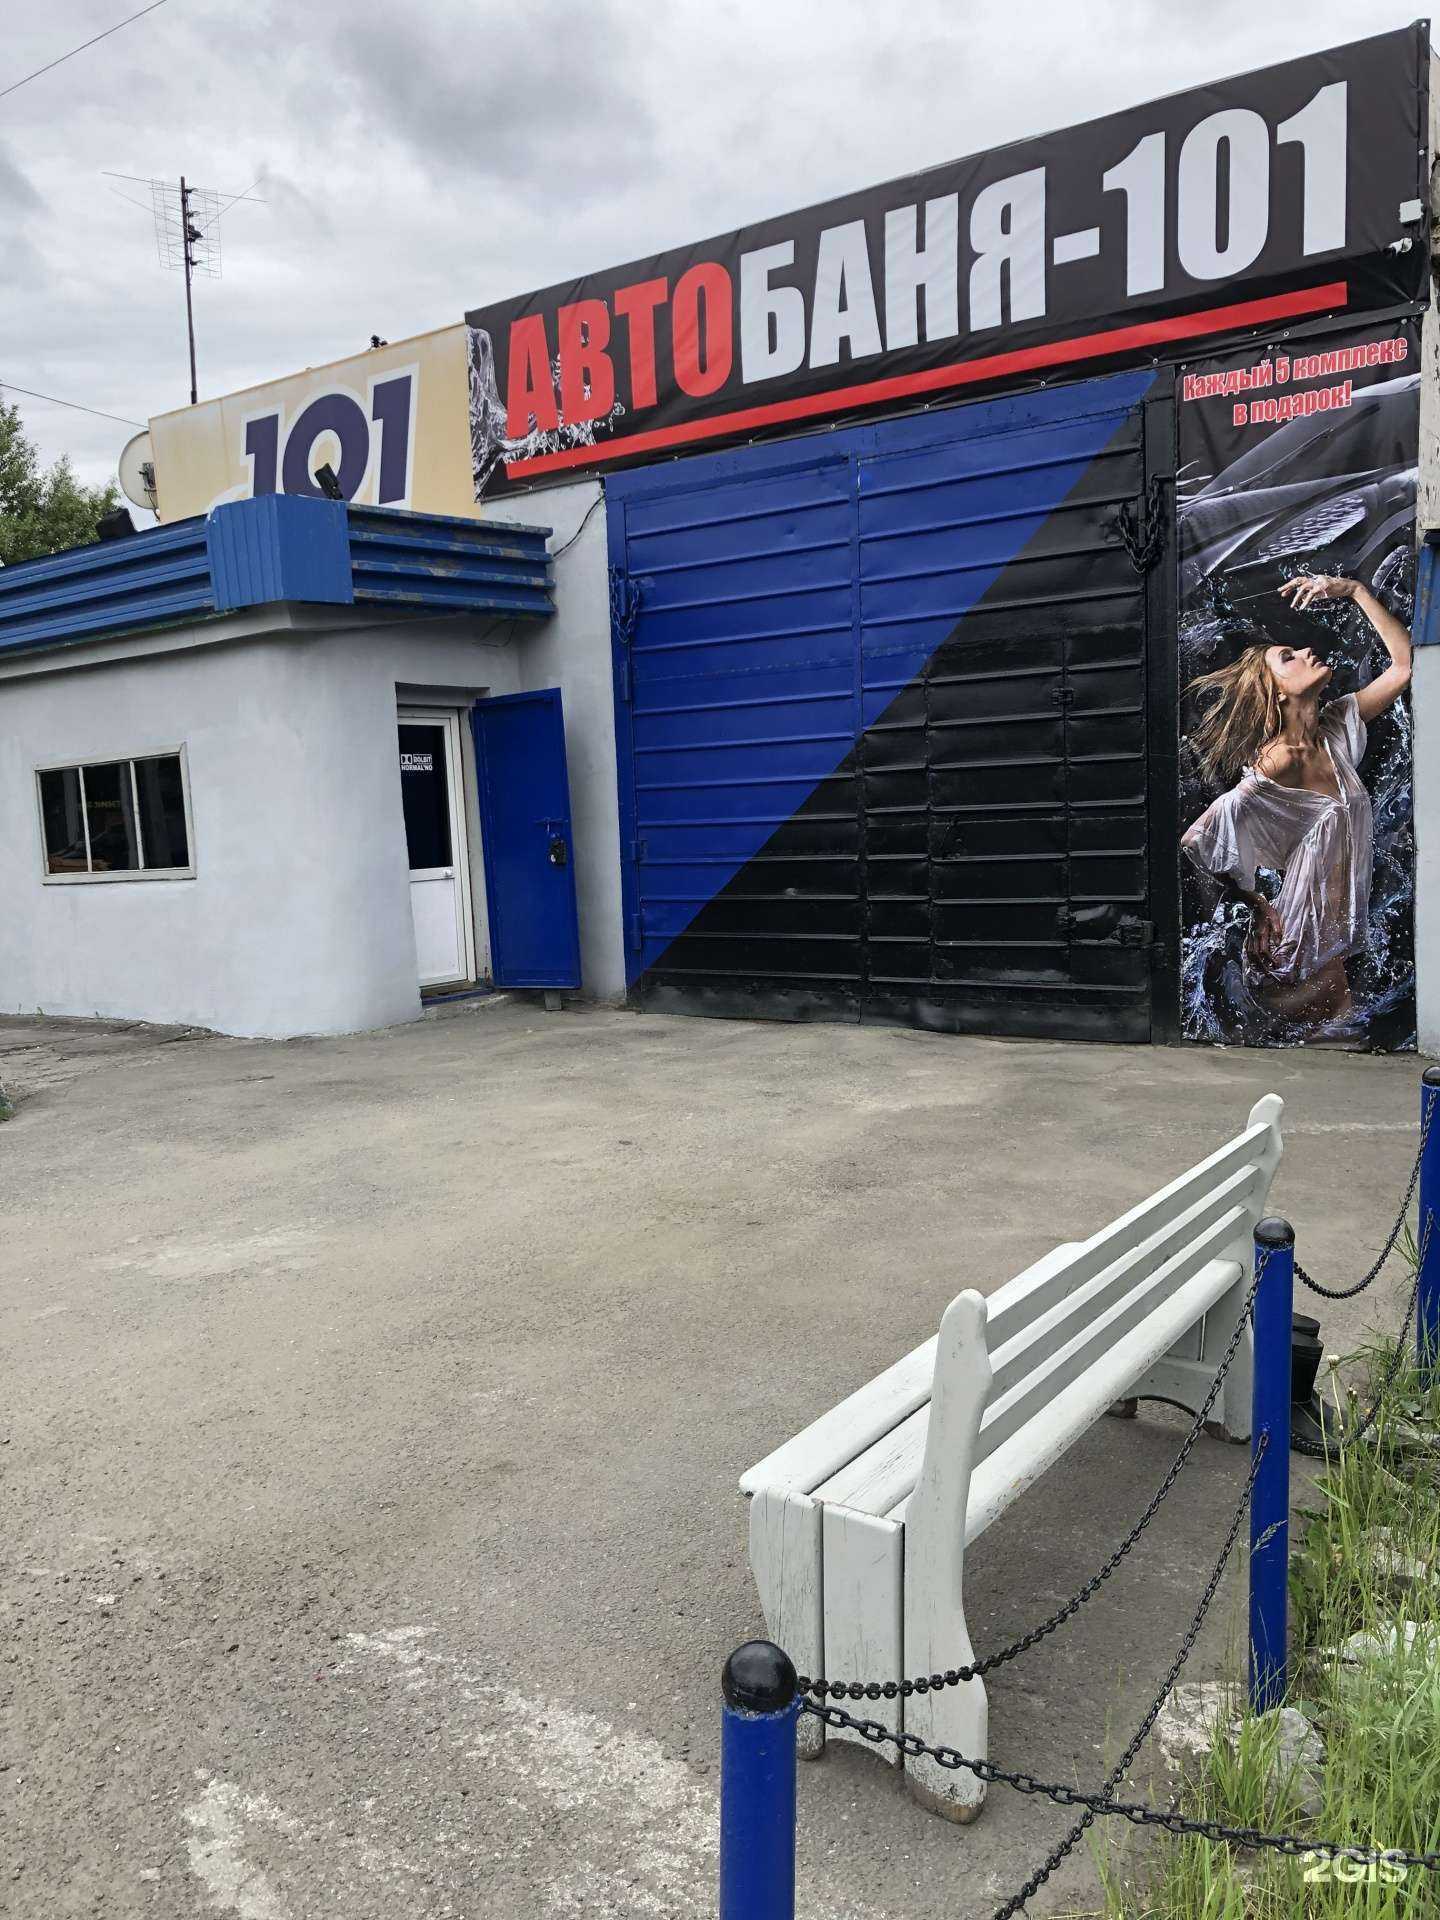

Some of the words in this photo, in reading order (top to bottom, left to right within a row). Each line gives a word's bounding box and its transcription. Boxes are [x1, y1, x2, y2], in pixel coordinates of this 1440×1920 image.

[506, 79, 1348, 439] АВТОБАНЯ-101
[1183, 360, 1273, 401] Каждый
[1275, 356, 1290, 384] 5
[1292, 337, 1408, 380] комплекс
[1233, 403, 1248, 426] в
[1250, 380, 1353, 422] подарок!
[245, 374, 413, 504] 101
